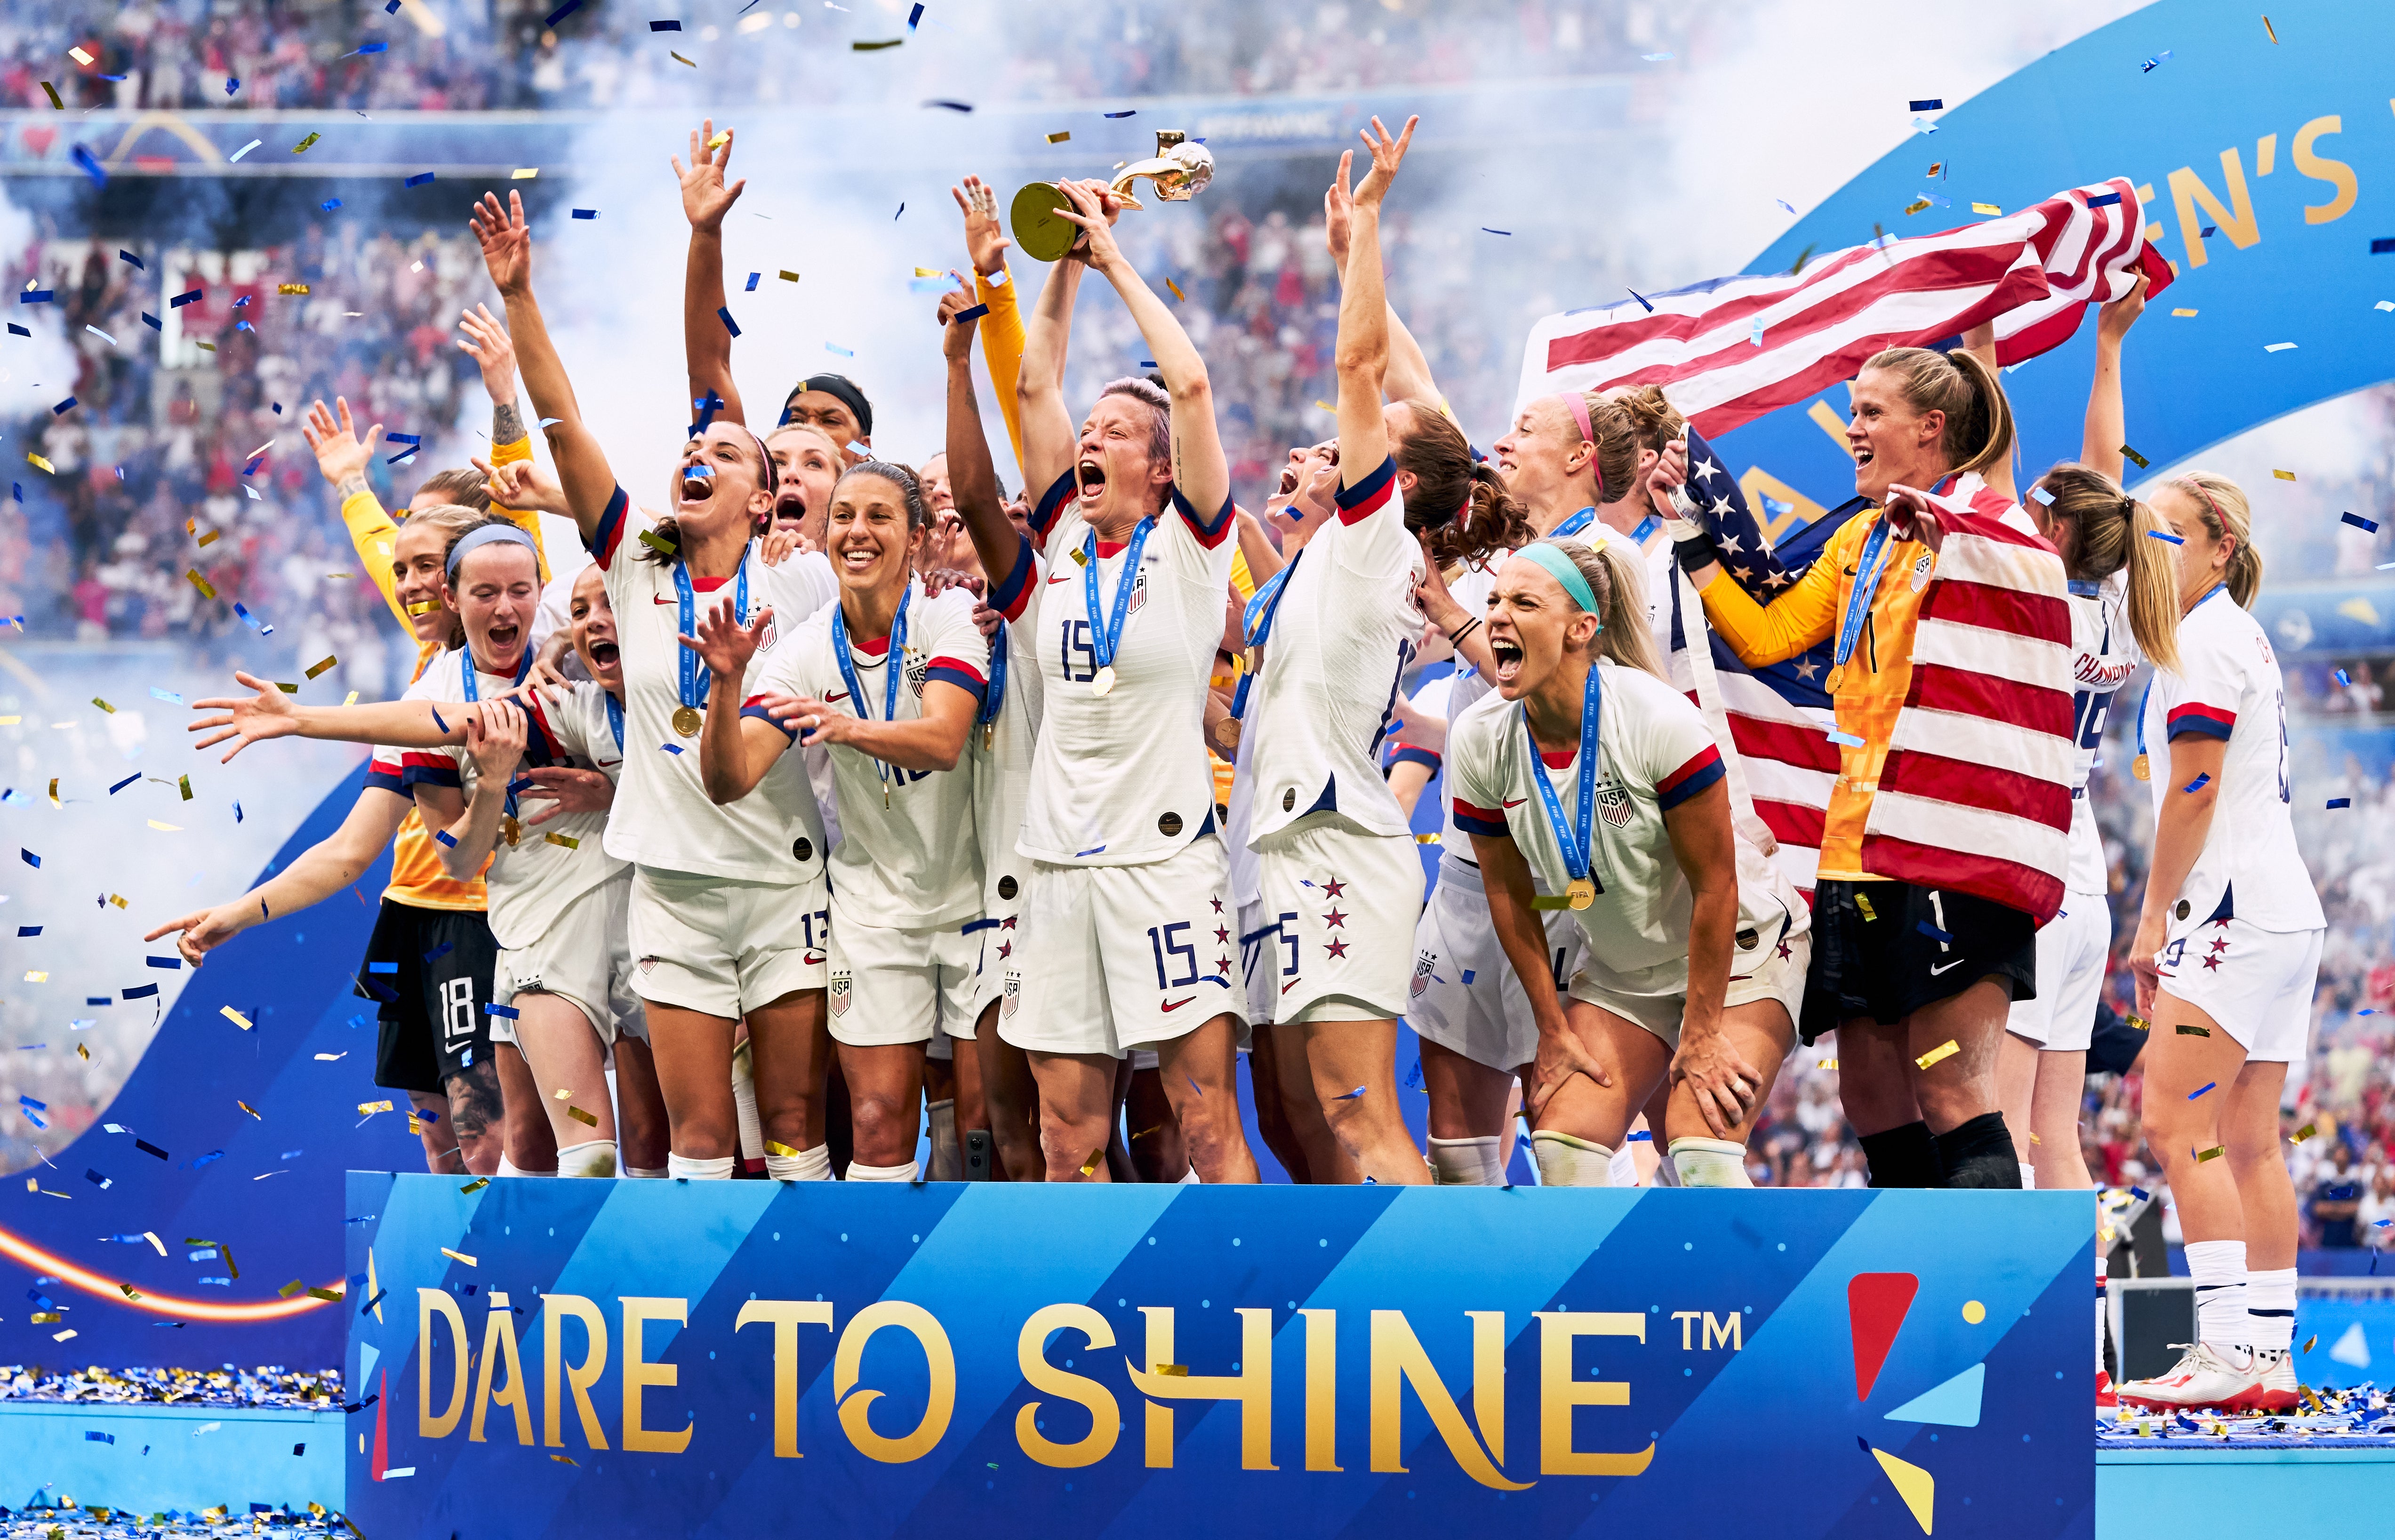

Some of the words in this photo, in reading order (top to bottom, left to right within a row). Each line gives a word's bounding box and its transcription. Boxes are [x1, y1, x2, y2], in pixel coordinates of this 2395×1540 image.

[1566, 520, 1578, 530] FIFA
[1916, 557, 1929, 573] USA
[1257, 591, 1266, 602] FIFA
[1867, 611, 1877, 674] 1
[1062, 619, 1098, 682] 15
[909, 666, 925, 681] US
[700, 677, 708, 689] FIFA
[1544, 786, 1553, 799] FIFA
[1600, 790, 1626, 806] USA
[1552, 805, 1560, 818] FIFA
[1559, 826, 1567, 839] FIFA
[1566, 846, 1574, 859] FIFA
[1570, 890, 1590, 898] FIFA
[1928, 890, 1950, 952] 1
[1147, 922, 1199, 989] 15
[1417, 960, 1431, 976] USA
[833, 981, 849, 995] USA
[1005, 982, 1018, 996] USA
[440, 977, 475, 1038] 18
[417, 1287, 693, 1454] DARE
[736, 1300, 956, 1463] TO
[1015, 1302, 1656, 1491] SHINE
[1670, 1310, 1743, 1351] TM
